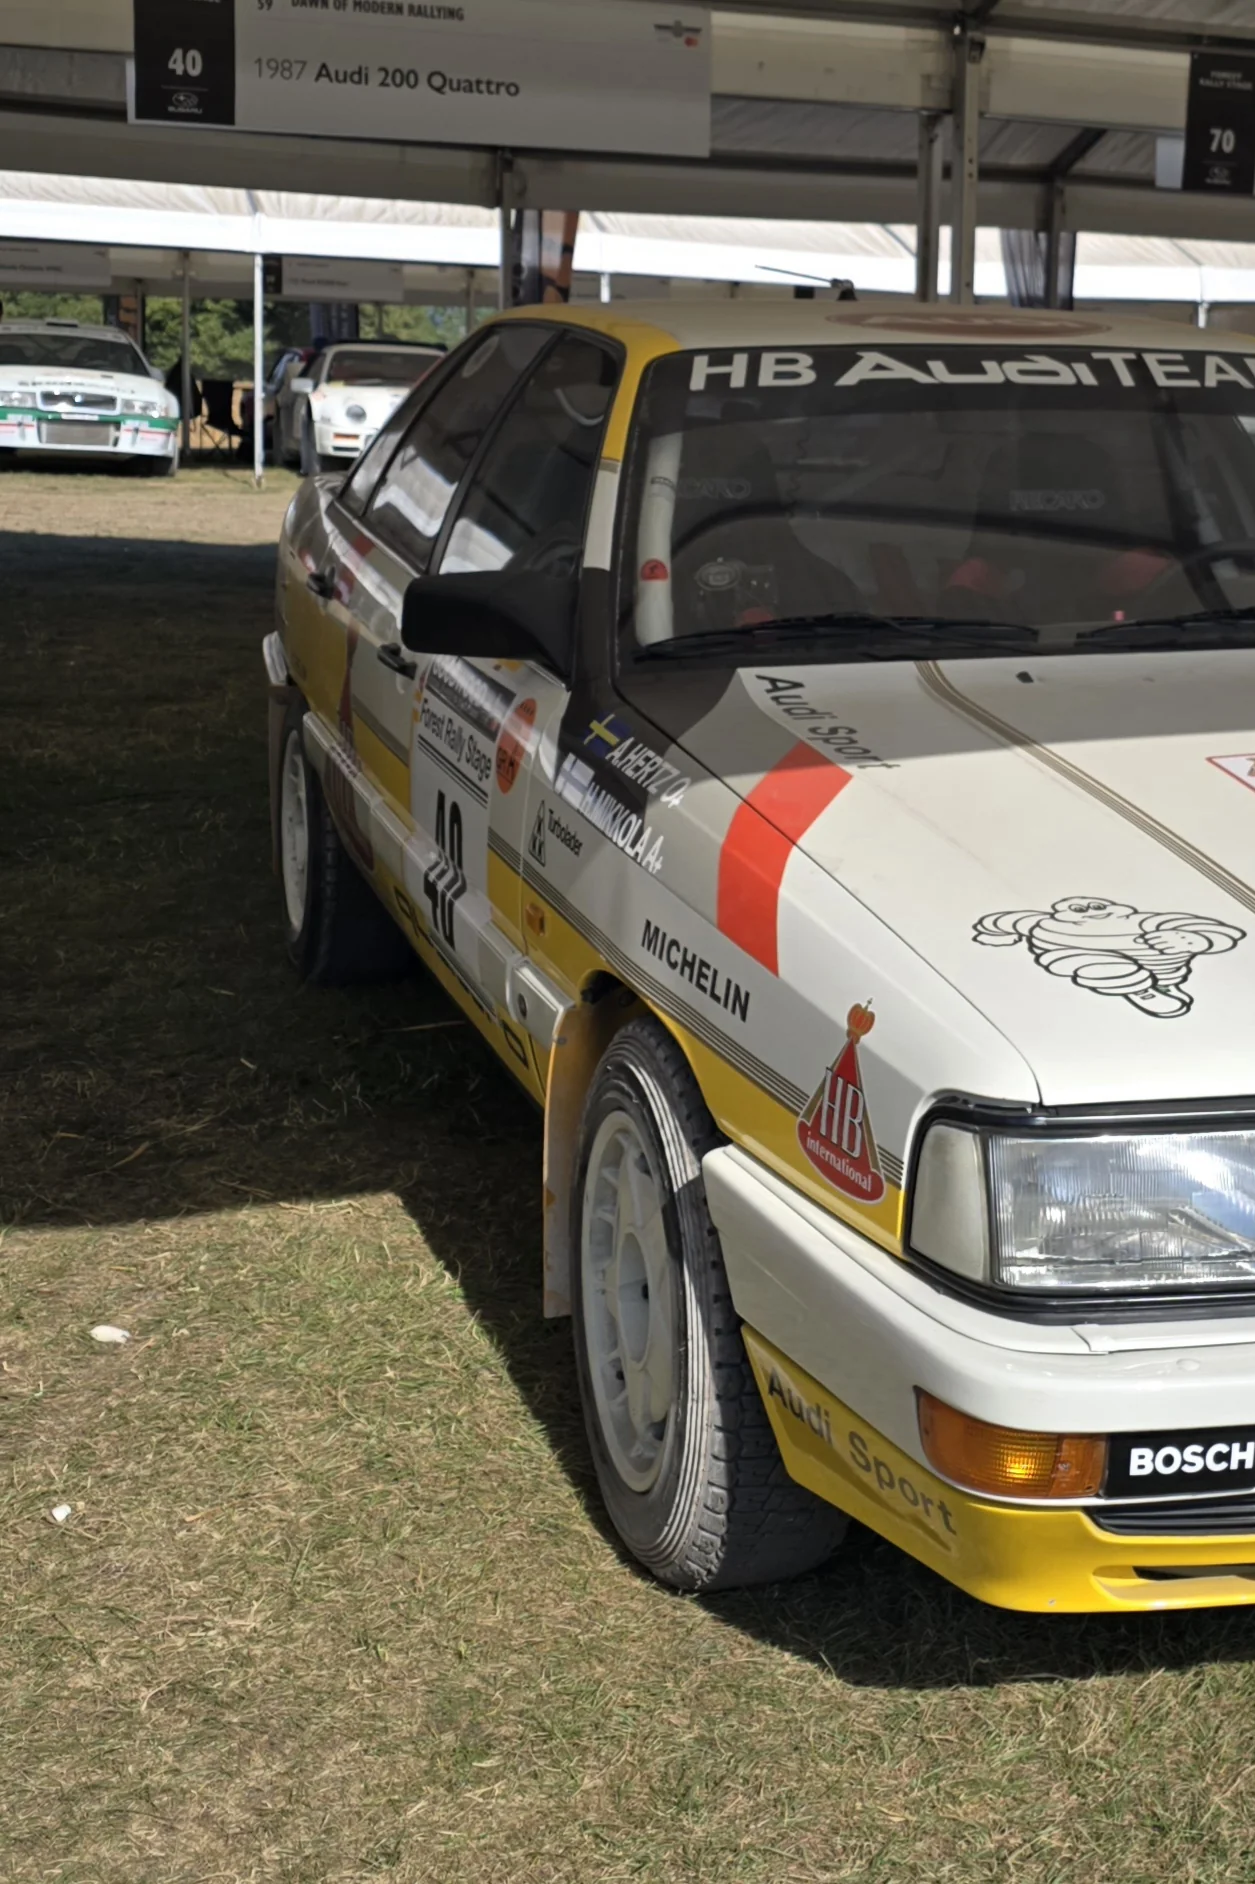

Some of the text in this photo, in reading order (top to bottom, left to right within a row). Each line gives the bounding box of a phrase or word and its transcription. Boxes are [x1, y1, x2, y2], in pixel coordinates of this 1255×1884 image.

[333, 0, 347, 12] OF
[353, 0, 403, 16] MODERN
[407, 4, 464, 21] RALLYING
[168, 48, 203, 76] 40
[254, 57, 520, 96] 1987 Audi 200 Quattro
[1209, 128, 1235, 153] 70
[689, 353, 816, 391] HB
[420, 697, 445, 741] Forest
[444, 717, 466, 763] Rally
[466, 735, 491, 781] Stage
[755, 674, 900, 769] Audi Sport
[641, 918, 750, 1023] MICHELIN
[820, 1068, 864, 1160] HB
[806, 1131, 872, 1192] international
[767, 1367, 957, 1535] Audi Sport
[1129, 1441, 1255, 1476] BOSCH
